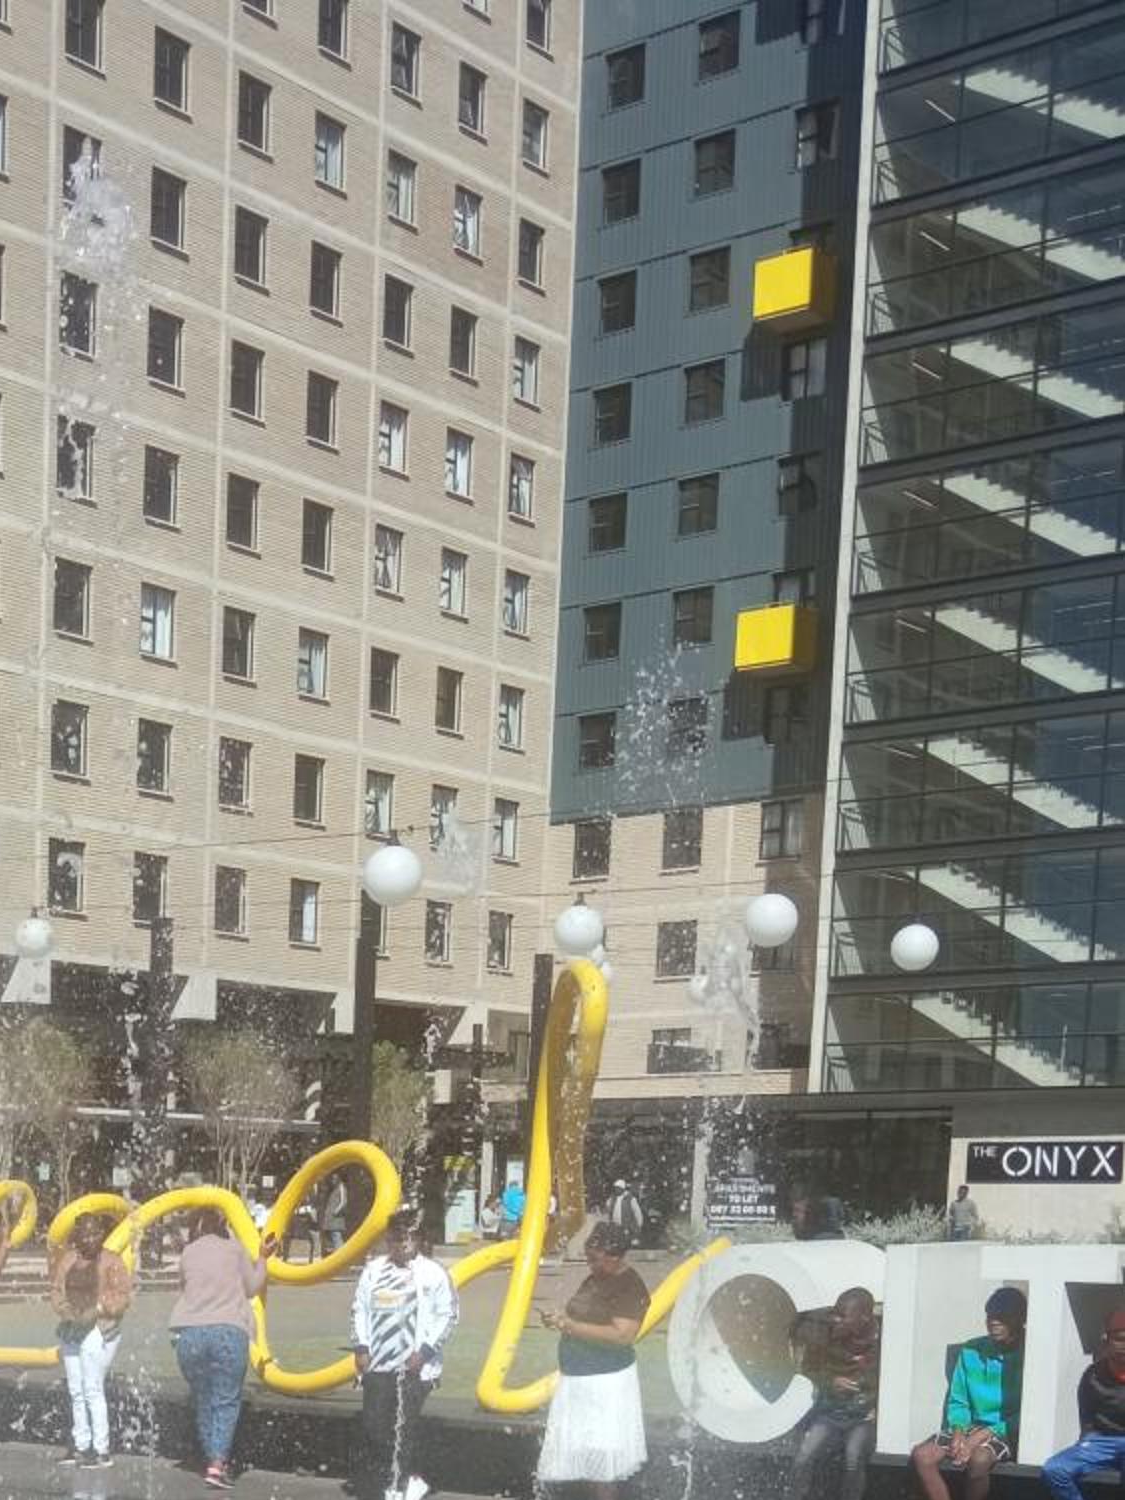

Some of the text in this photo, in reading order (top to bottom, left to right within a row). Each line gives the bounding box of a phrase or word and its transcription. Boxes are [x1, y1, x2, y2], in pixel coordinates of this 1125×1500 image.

[973, 1145, 1117, 1177] THE ONYX
[667, 1240, 1125, 1468] CIT
